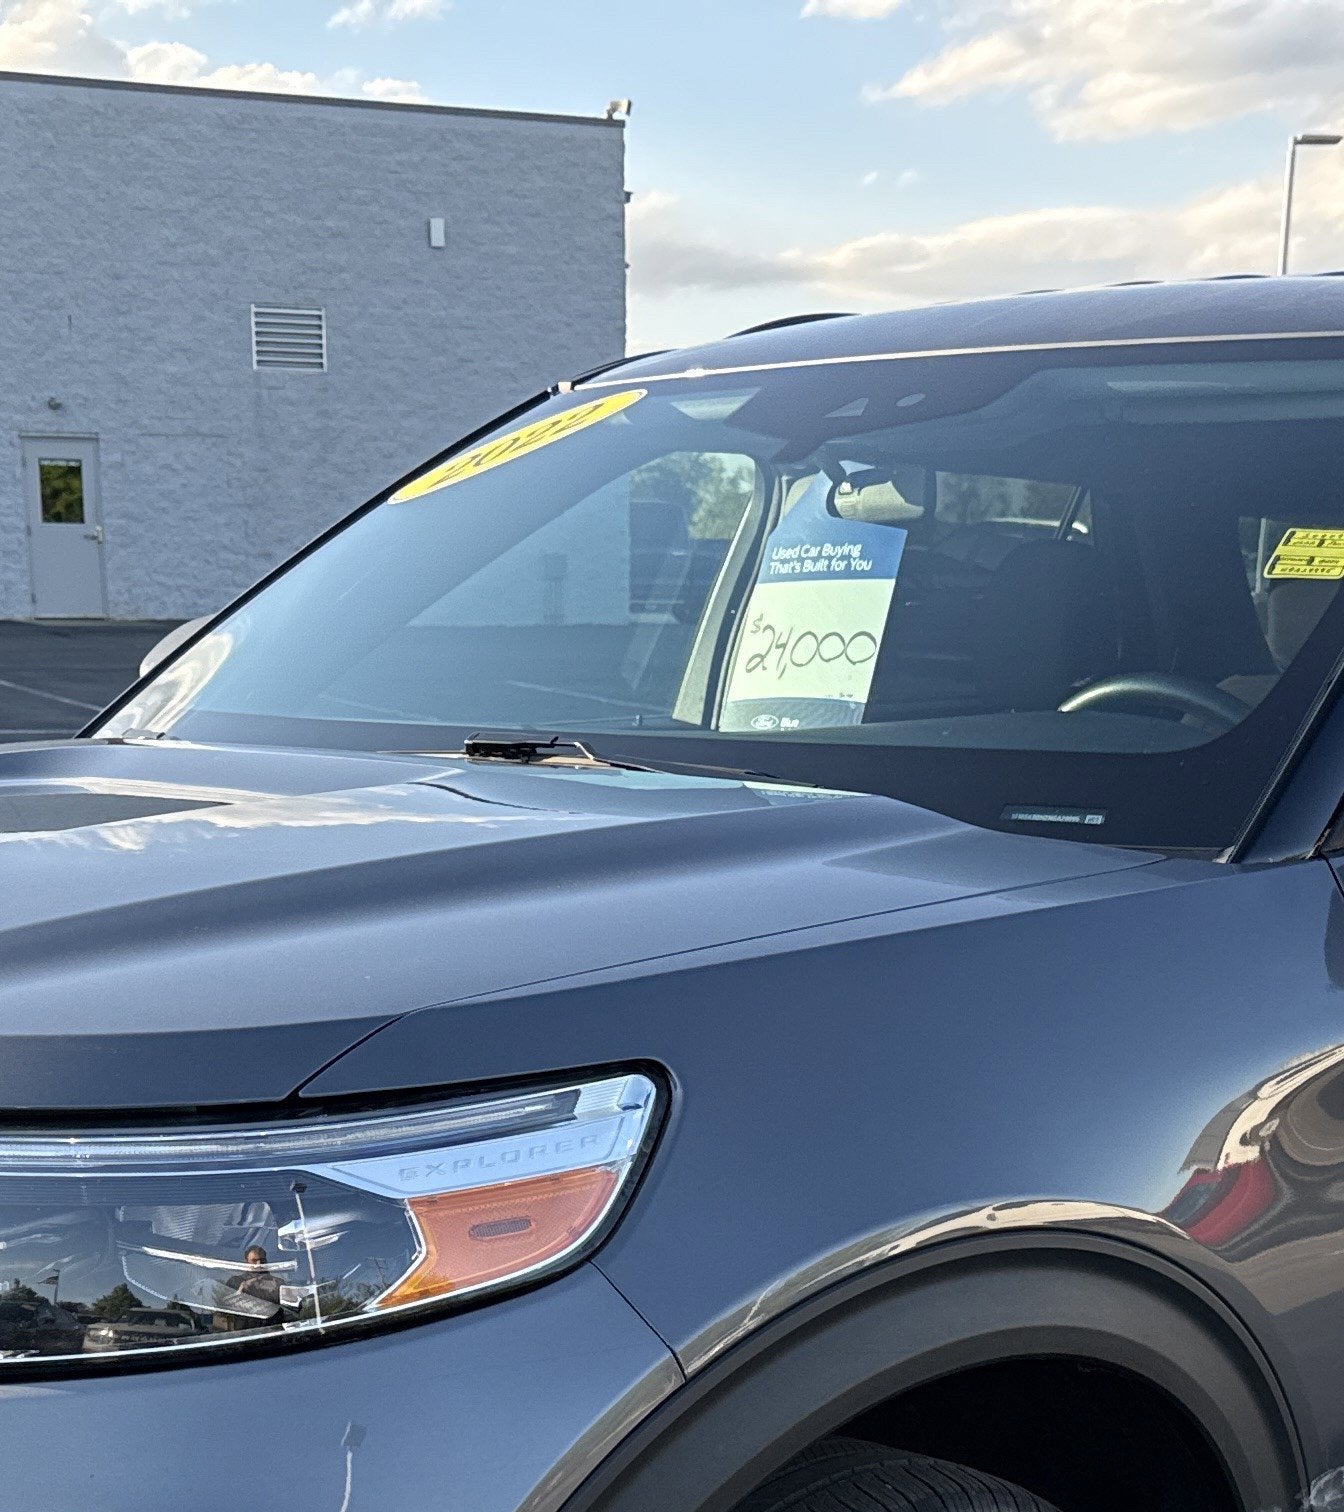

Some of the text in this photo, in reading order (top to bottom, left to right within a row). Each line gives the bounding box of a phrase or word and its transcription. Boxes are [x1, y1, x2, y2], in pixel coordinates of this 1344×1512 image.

[425, 402, 606, 490] 2022
[770, 558, 873, 575] That's Built for You
[772, 542, 862, 559] Used Car Buying
[398, 1134, 599, 1182] EXPLORER
